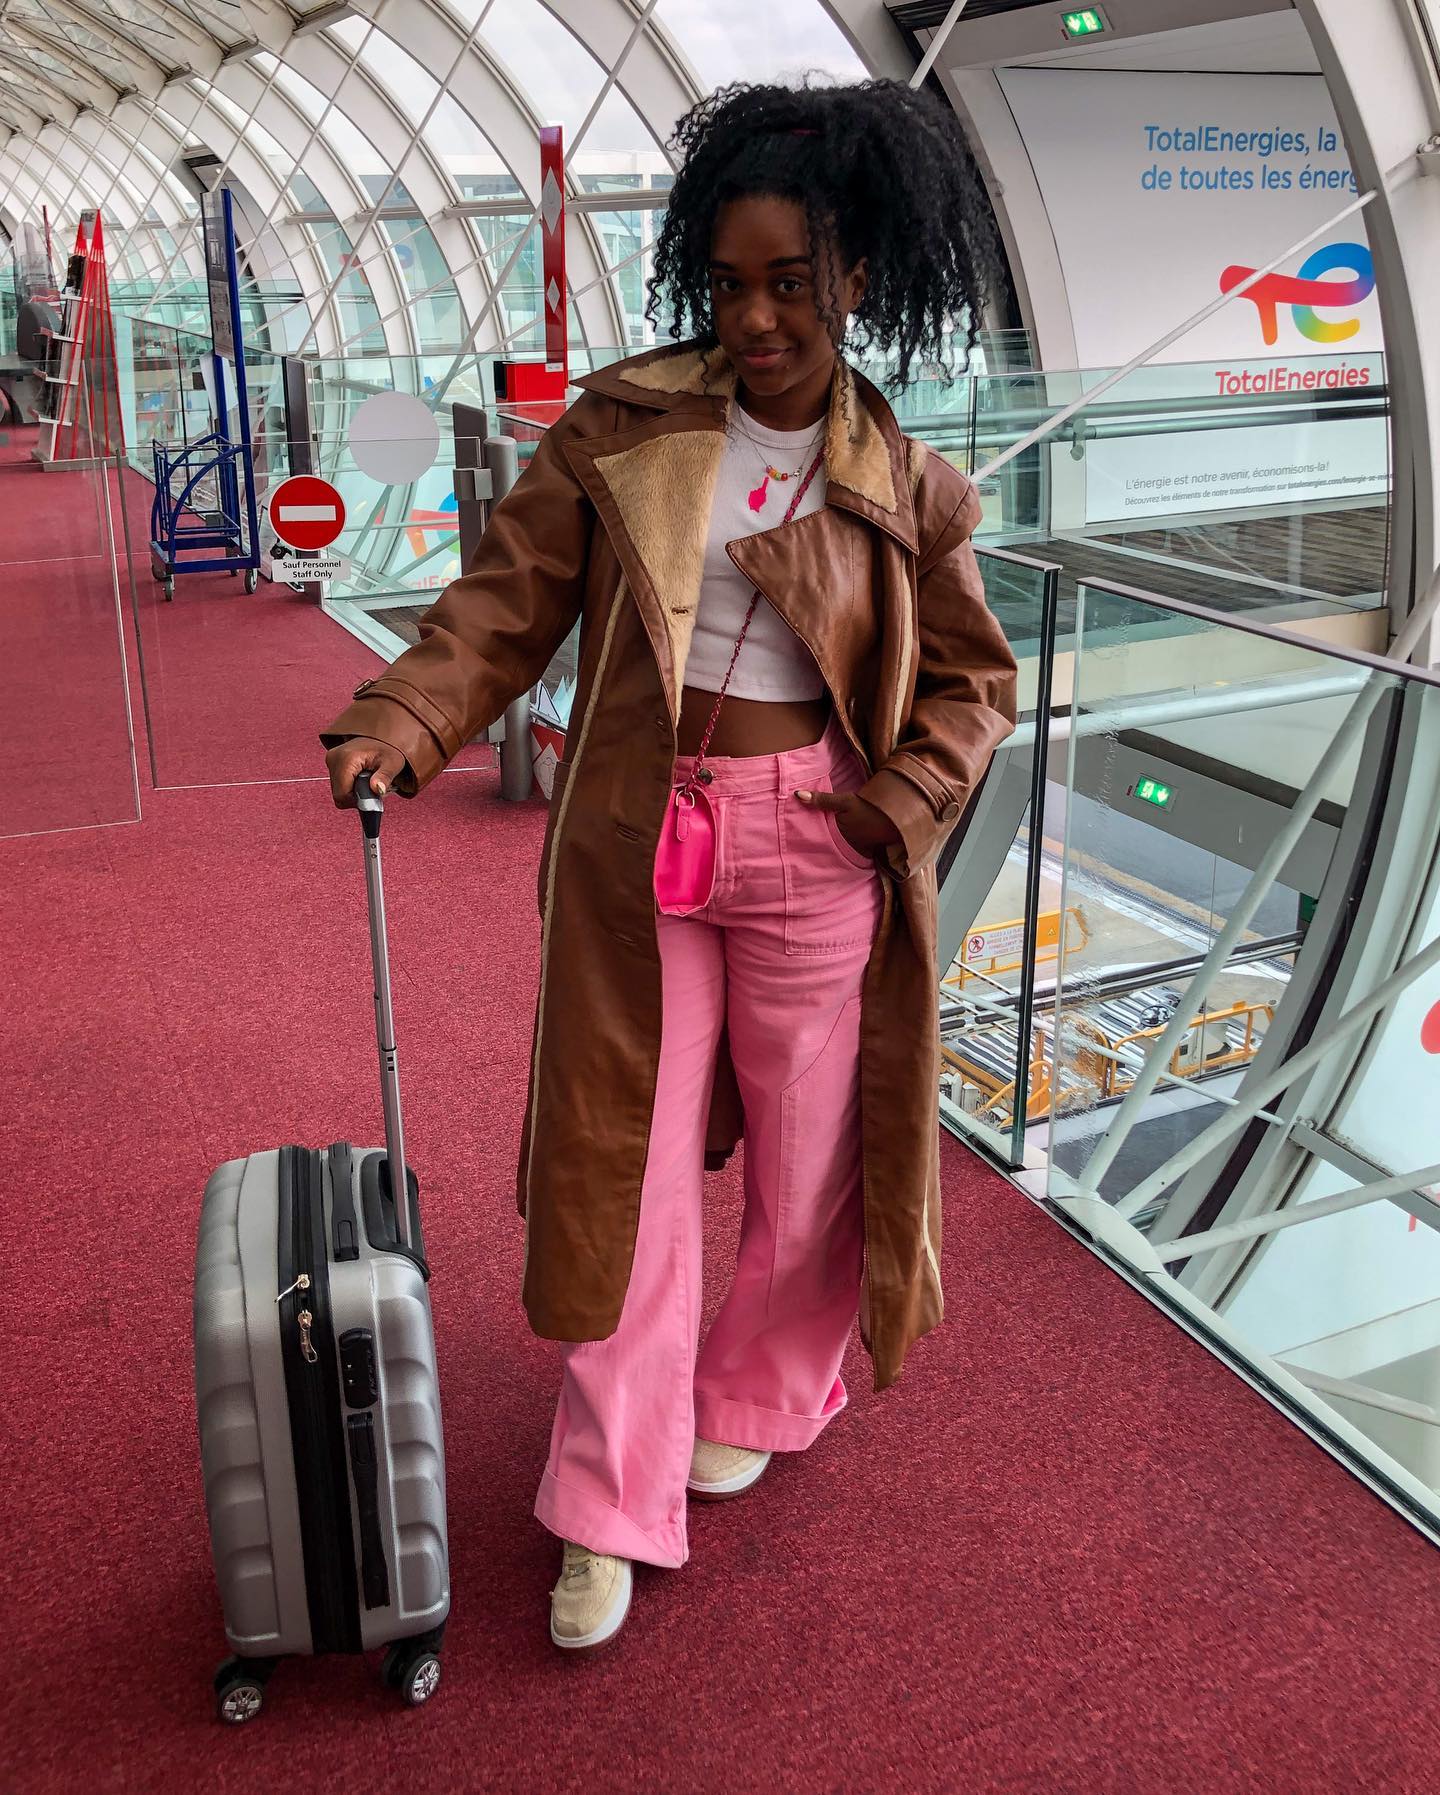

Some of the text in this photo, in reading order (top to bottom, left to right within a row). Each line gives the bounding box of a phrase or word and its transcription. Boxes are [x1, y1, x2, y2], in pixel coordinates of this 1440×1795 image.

[1144, 126, 1337, 157] TotalEnergies, la
[1141, 164, 1172, 190] de
[1180, 166, 1254, 190] toutes
[1261, 164, 1292, 190] les
[1215, 362, 1370, 395] TotalEnergies
[1125, 476, 1172, 490] L'énergie
[1173, 475, 1190, 485] est
[1191, 473, 1218, 484] notre
[1219, 470, 1250, 481] avenir,
[1202, 489, 1211, 498] de
[282, 560, 342, 569] Sauf Personnel
[292, 570, 333, 579] Staff Only
